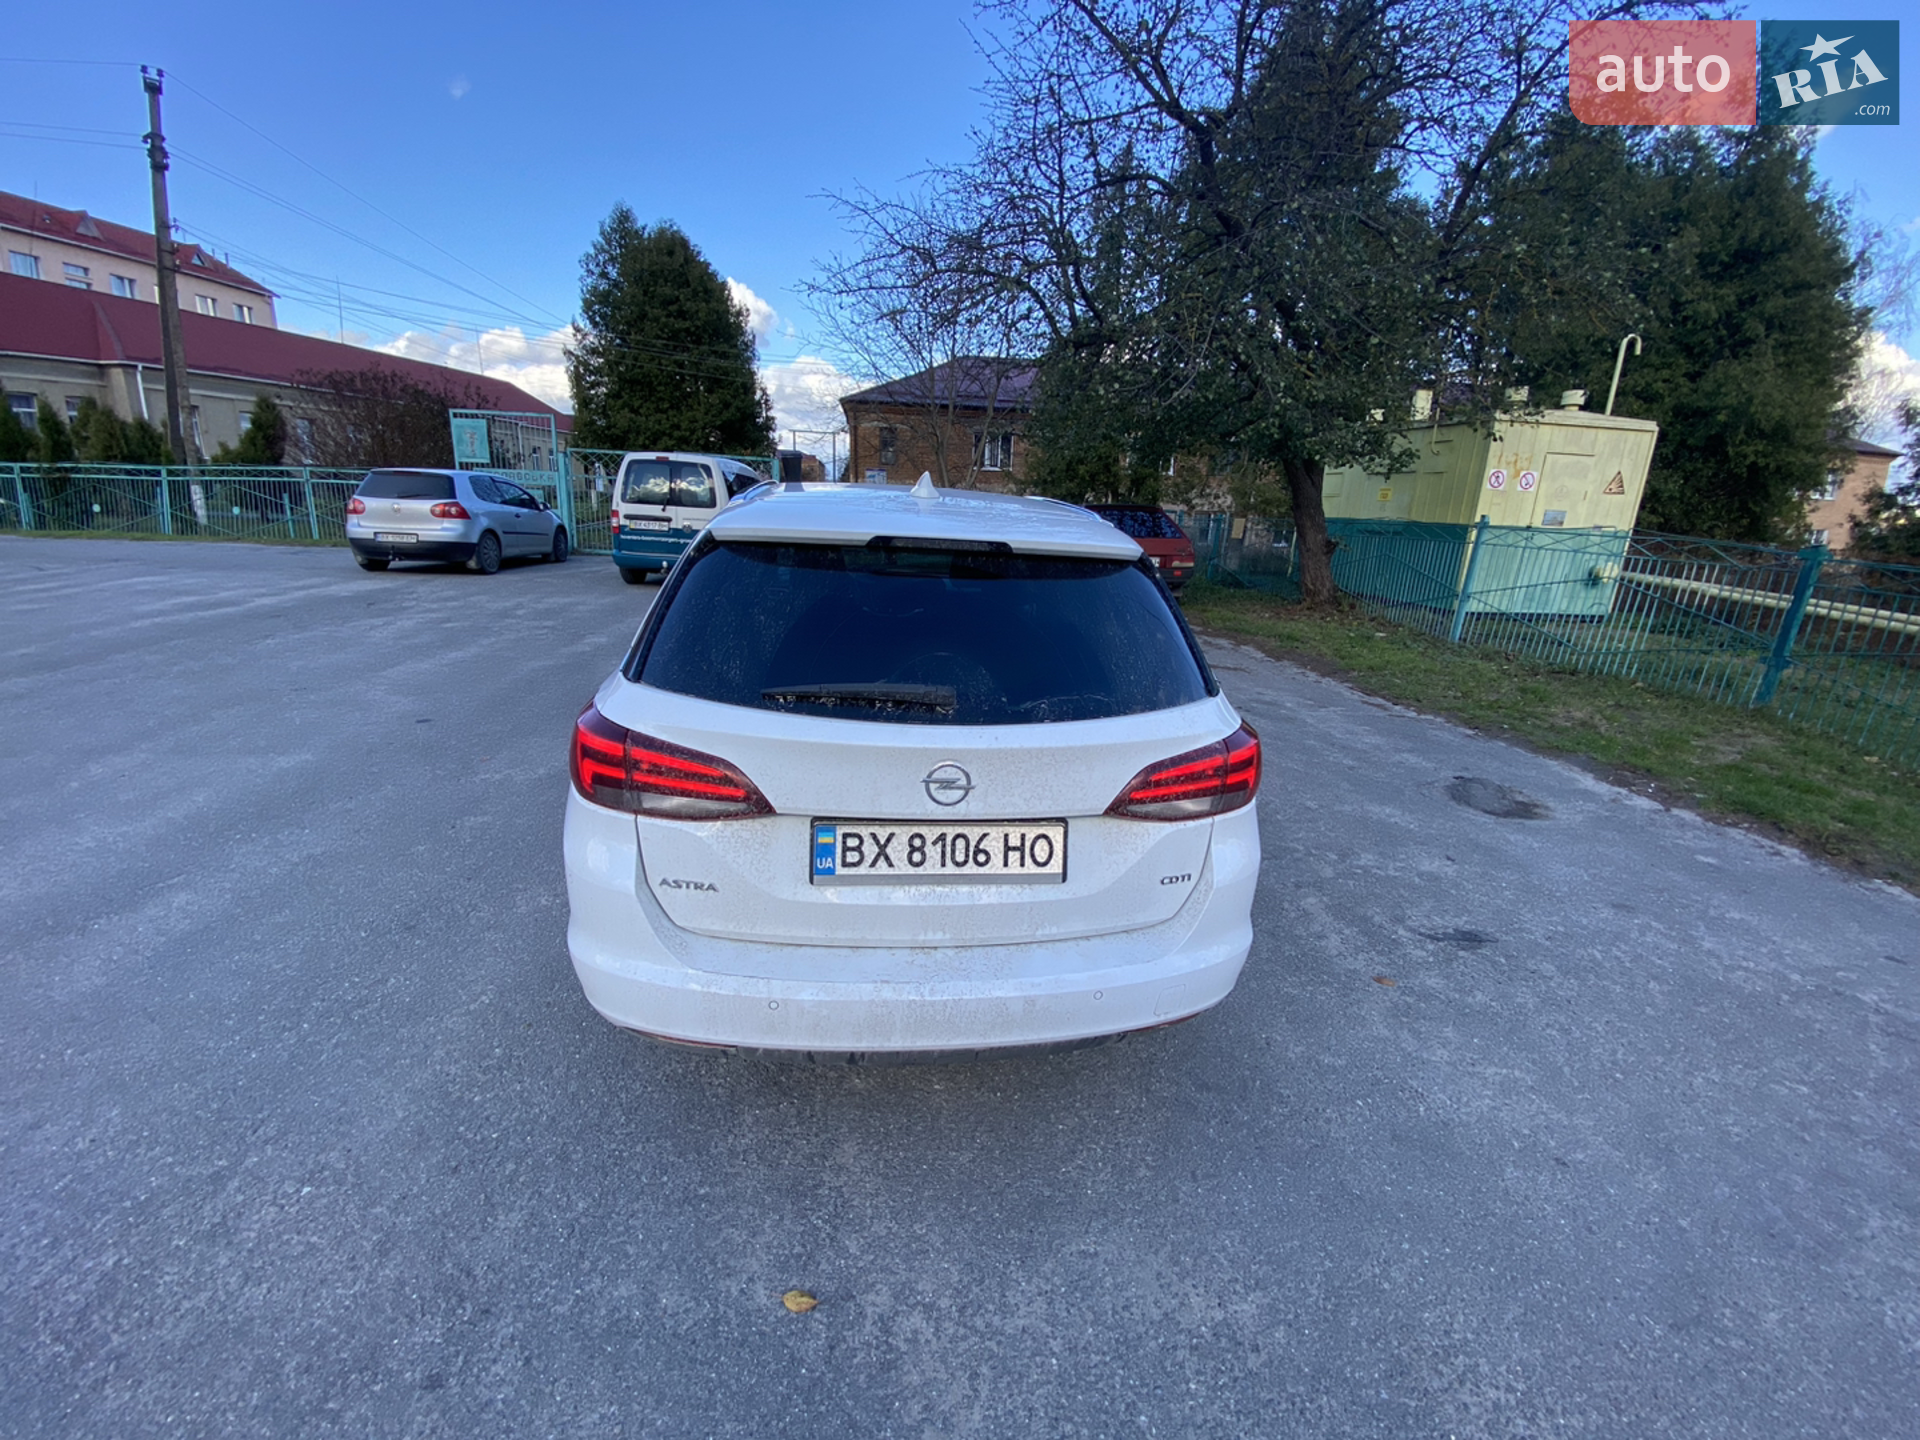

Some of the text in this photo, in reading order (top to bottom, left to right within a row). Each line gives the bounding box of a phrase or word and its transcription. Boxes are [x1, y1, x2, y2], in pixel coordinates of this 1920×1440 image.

[841, 832, 1054, 868] BX 8106 HO
[816, 858, 834, 869] UA
[659, 878, 719, 893] ASTRA
